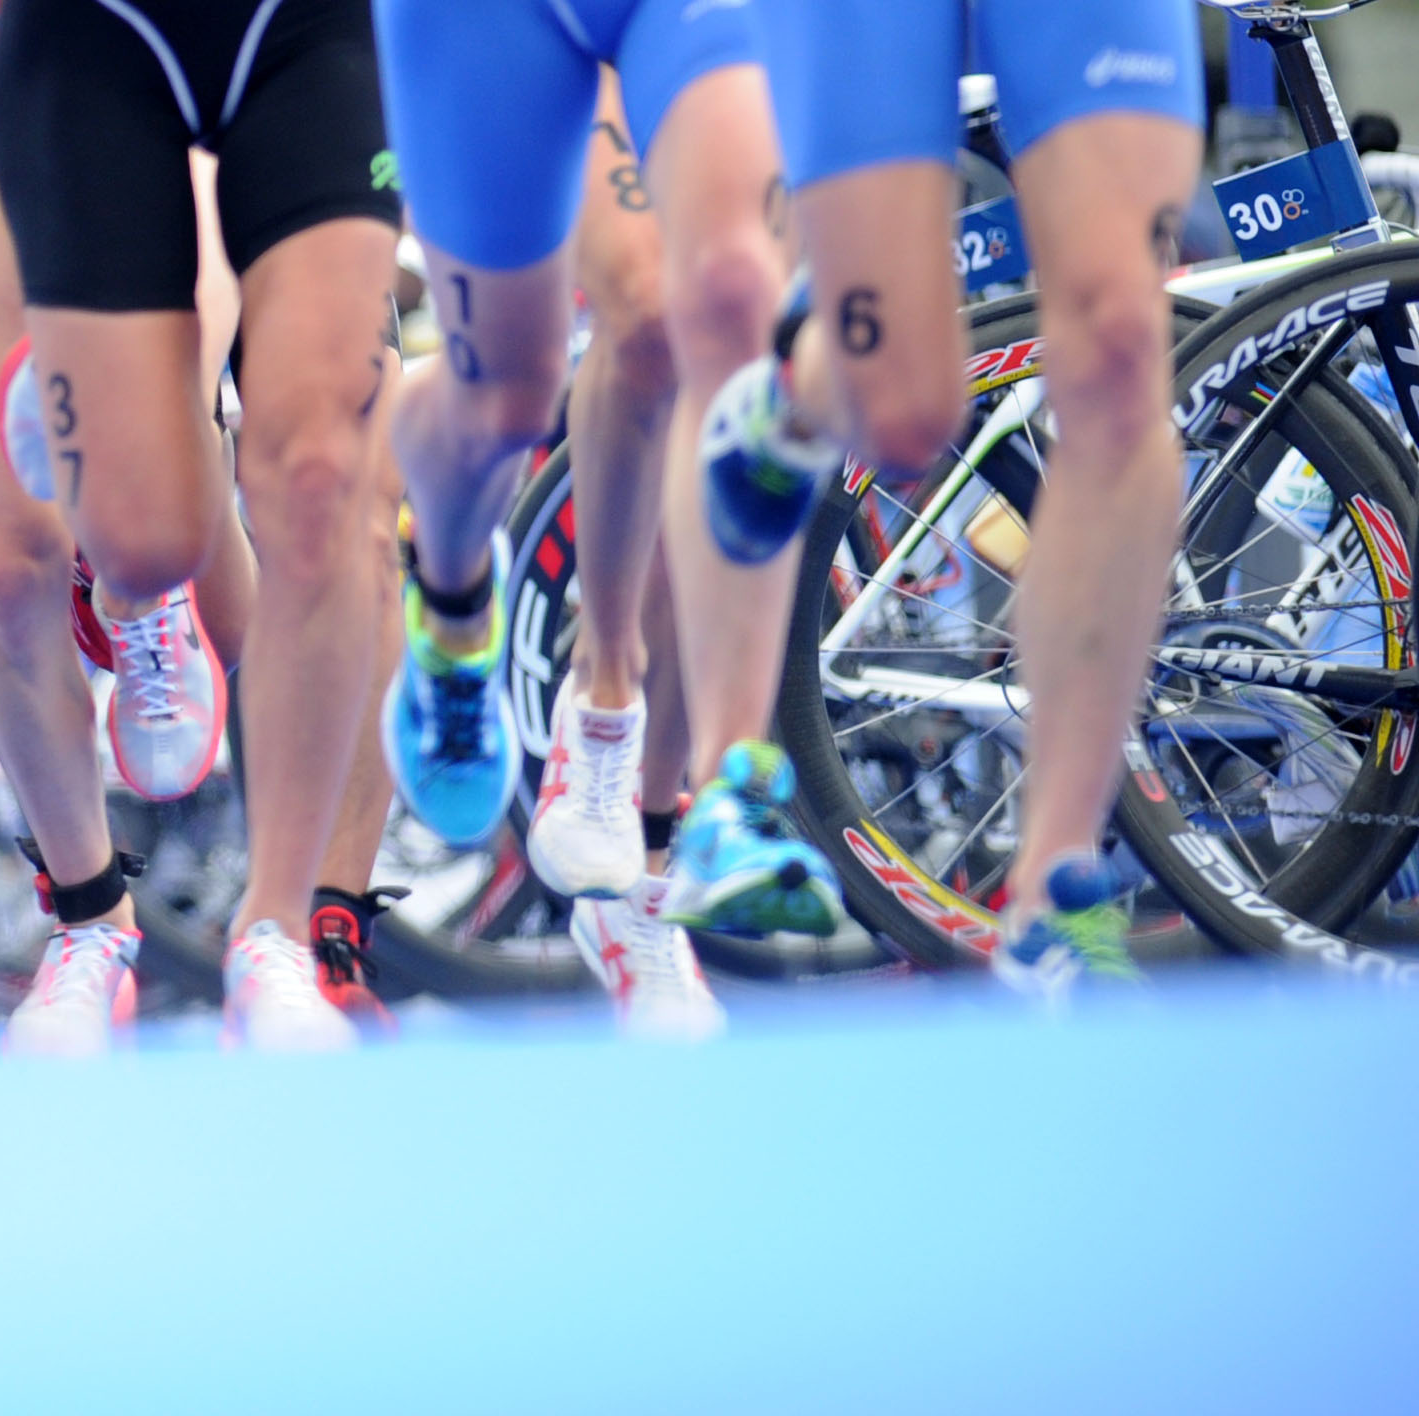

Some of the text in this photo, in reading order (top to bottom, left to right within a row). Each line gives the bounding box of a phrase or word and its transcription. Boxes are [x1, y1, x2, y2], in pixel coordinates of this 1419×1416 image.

[1228, 193, 1283, 241] 30
[838, 288, 881, 356] 6
[1159, 647, 1338, 687] GIANT
